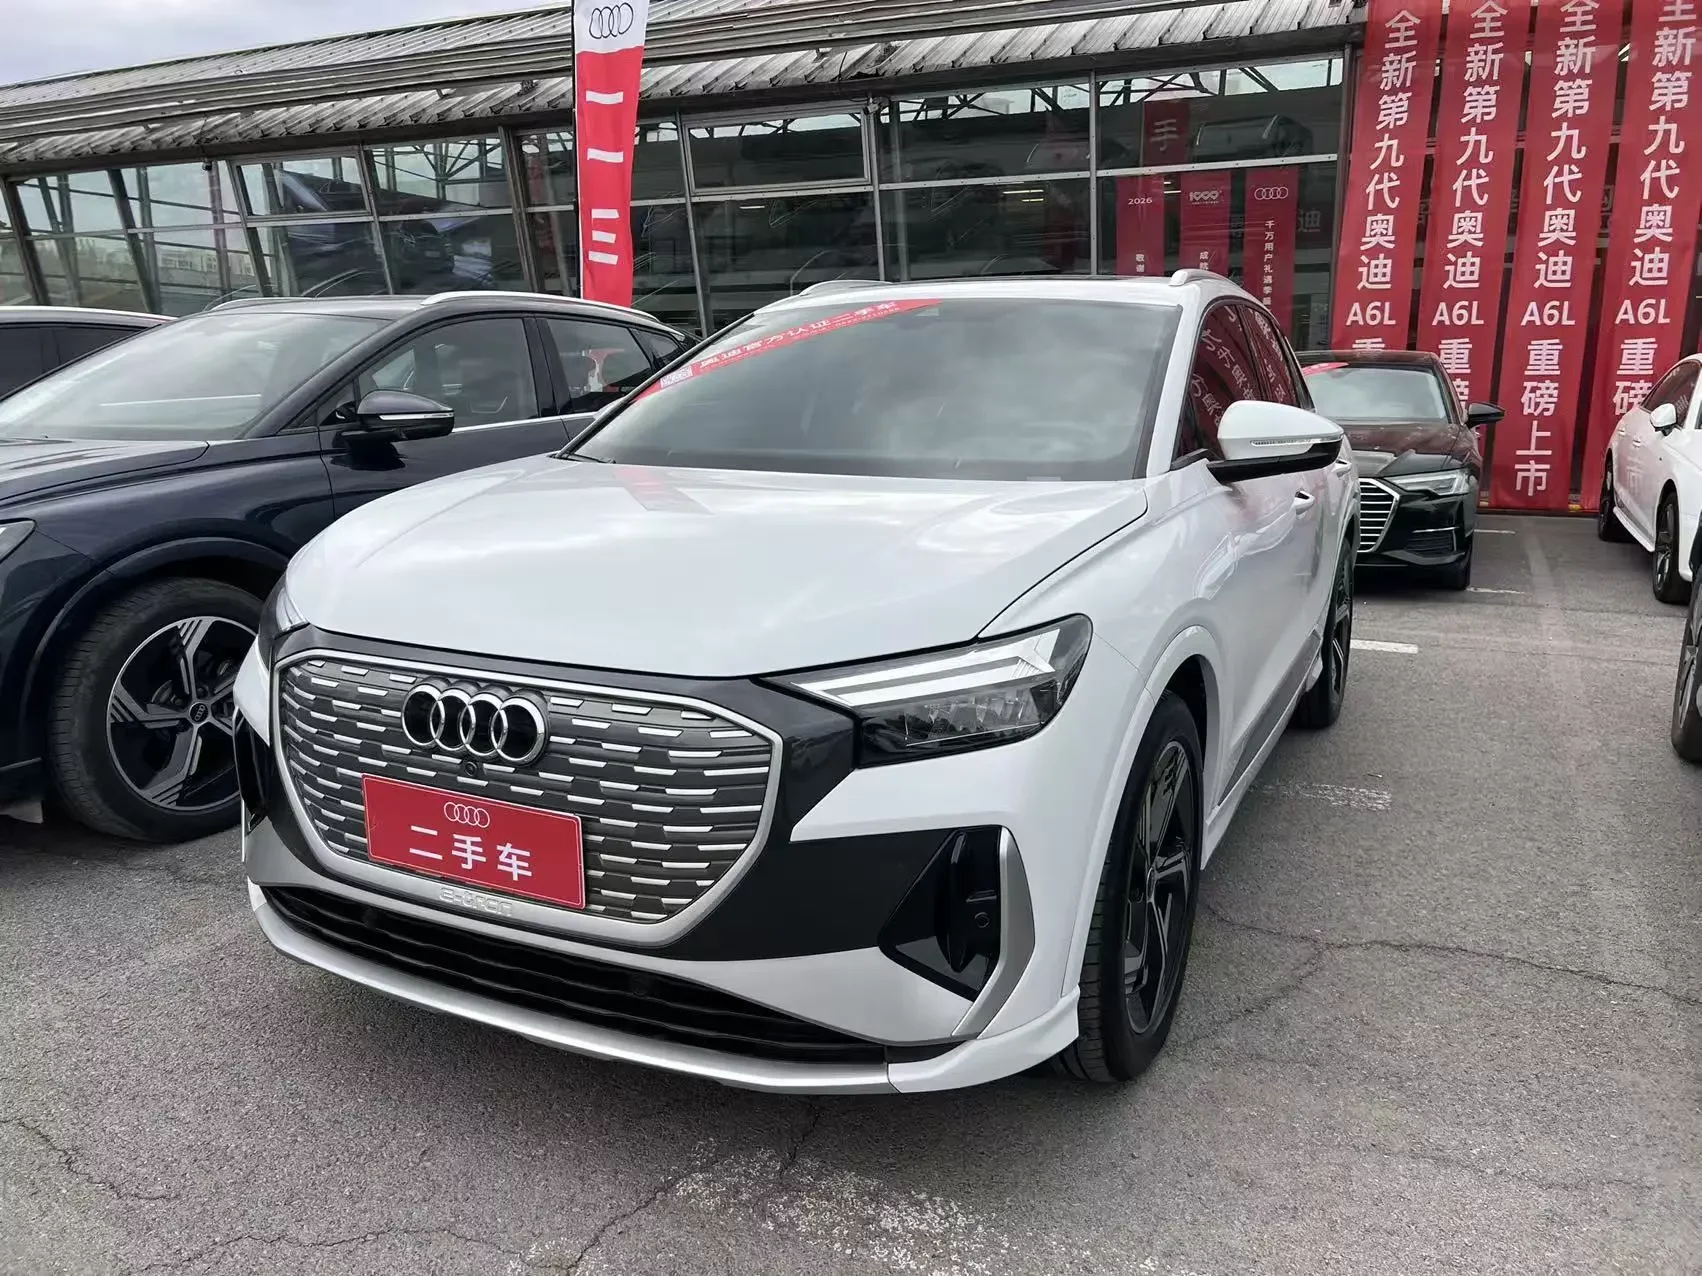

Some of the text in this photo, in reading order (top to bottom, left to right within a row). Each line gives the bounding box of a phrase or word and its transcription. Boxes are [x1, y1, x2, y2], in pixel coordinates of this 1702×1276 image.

[1128, 196, 1153, 205] 2026
[409, 825, 533, 881] 二手车
